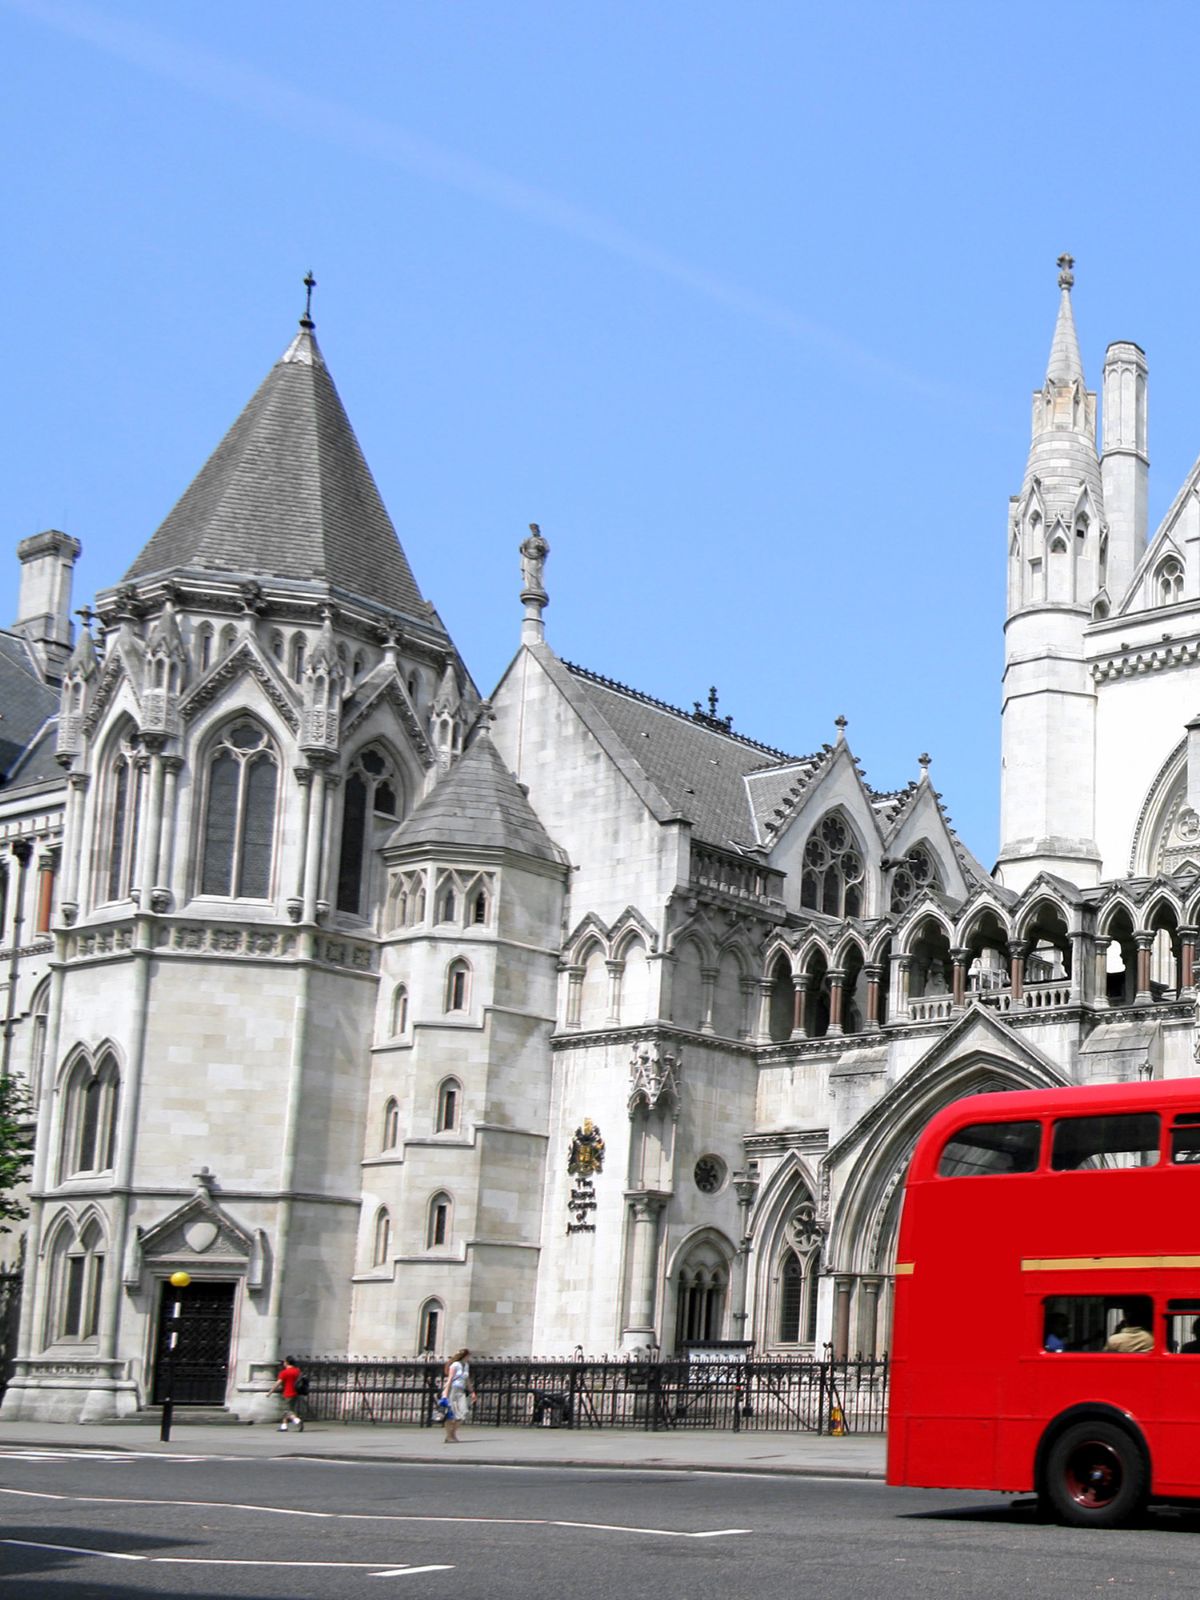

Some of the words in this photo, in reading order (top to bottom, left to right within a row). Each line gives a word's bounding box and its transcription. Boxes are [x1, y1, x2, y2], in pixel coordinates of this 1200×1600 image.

[575, 1178, 593, 1190] The
[576, 1210, 587, 1223] of
[565, 1221, 596, 1236] Justice
